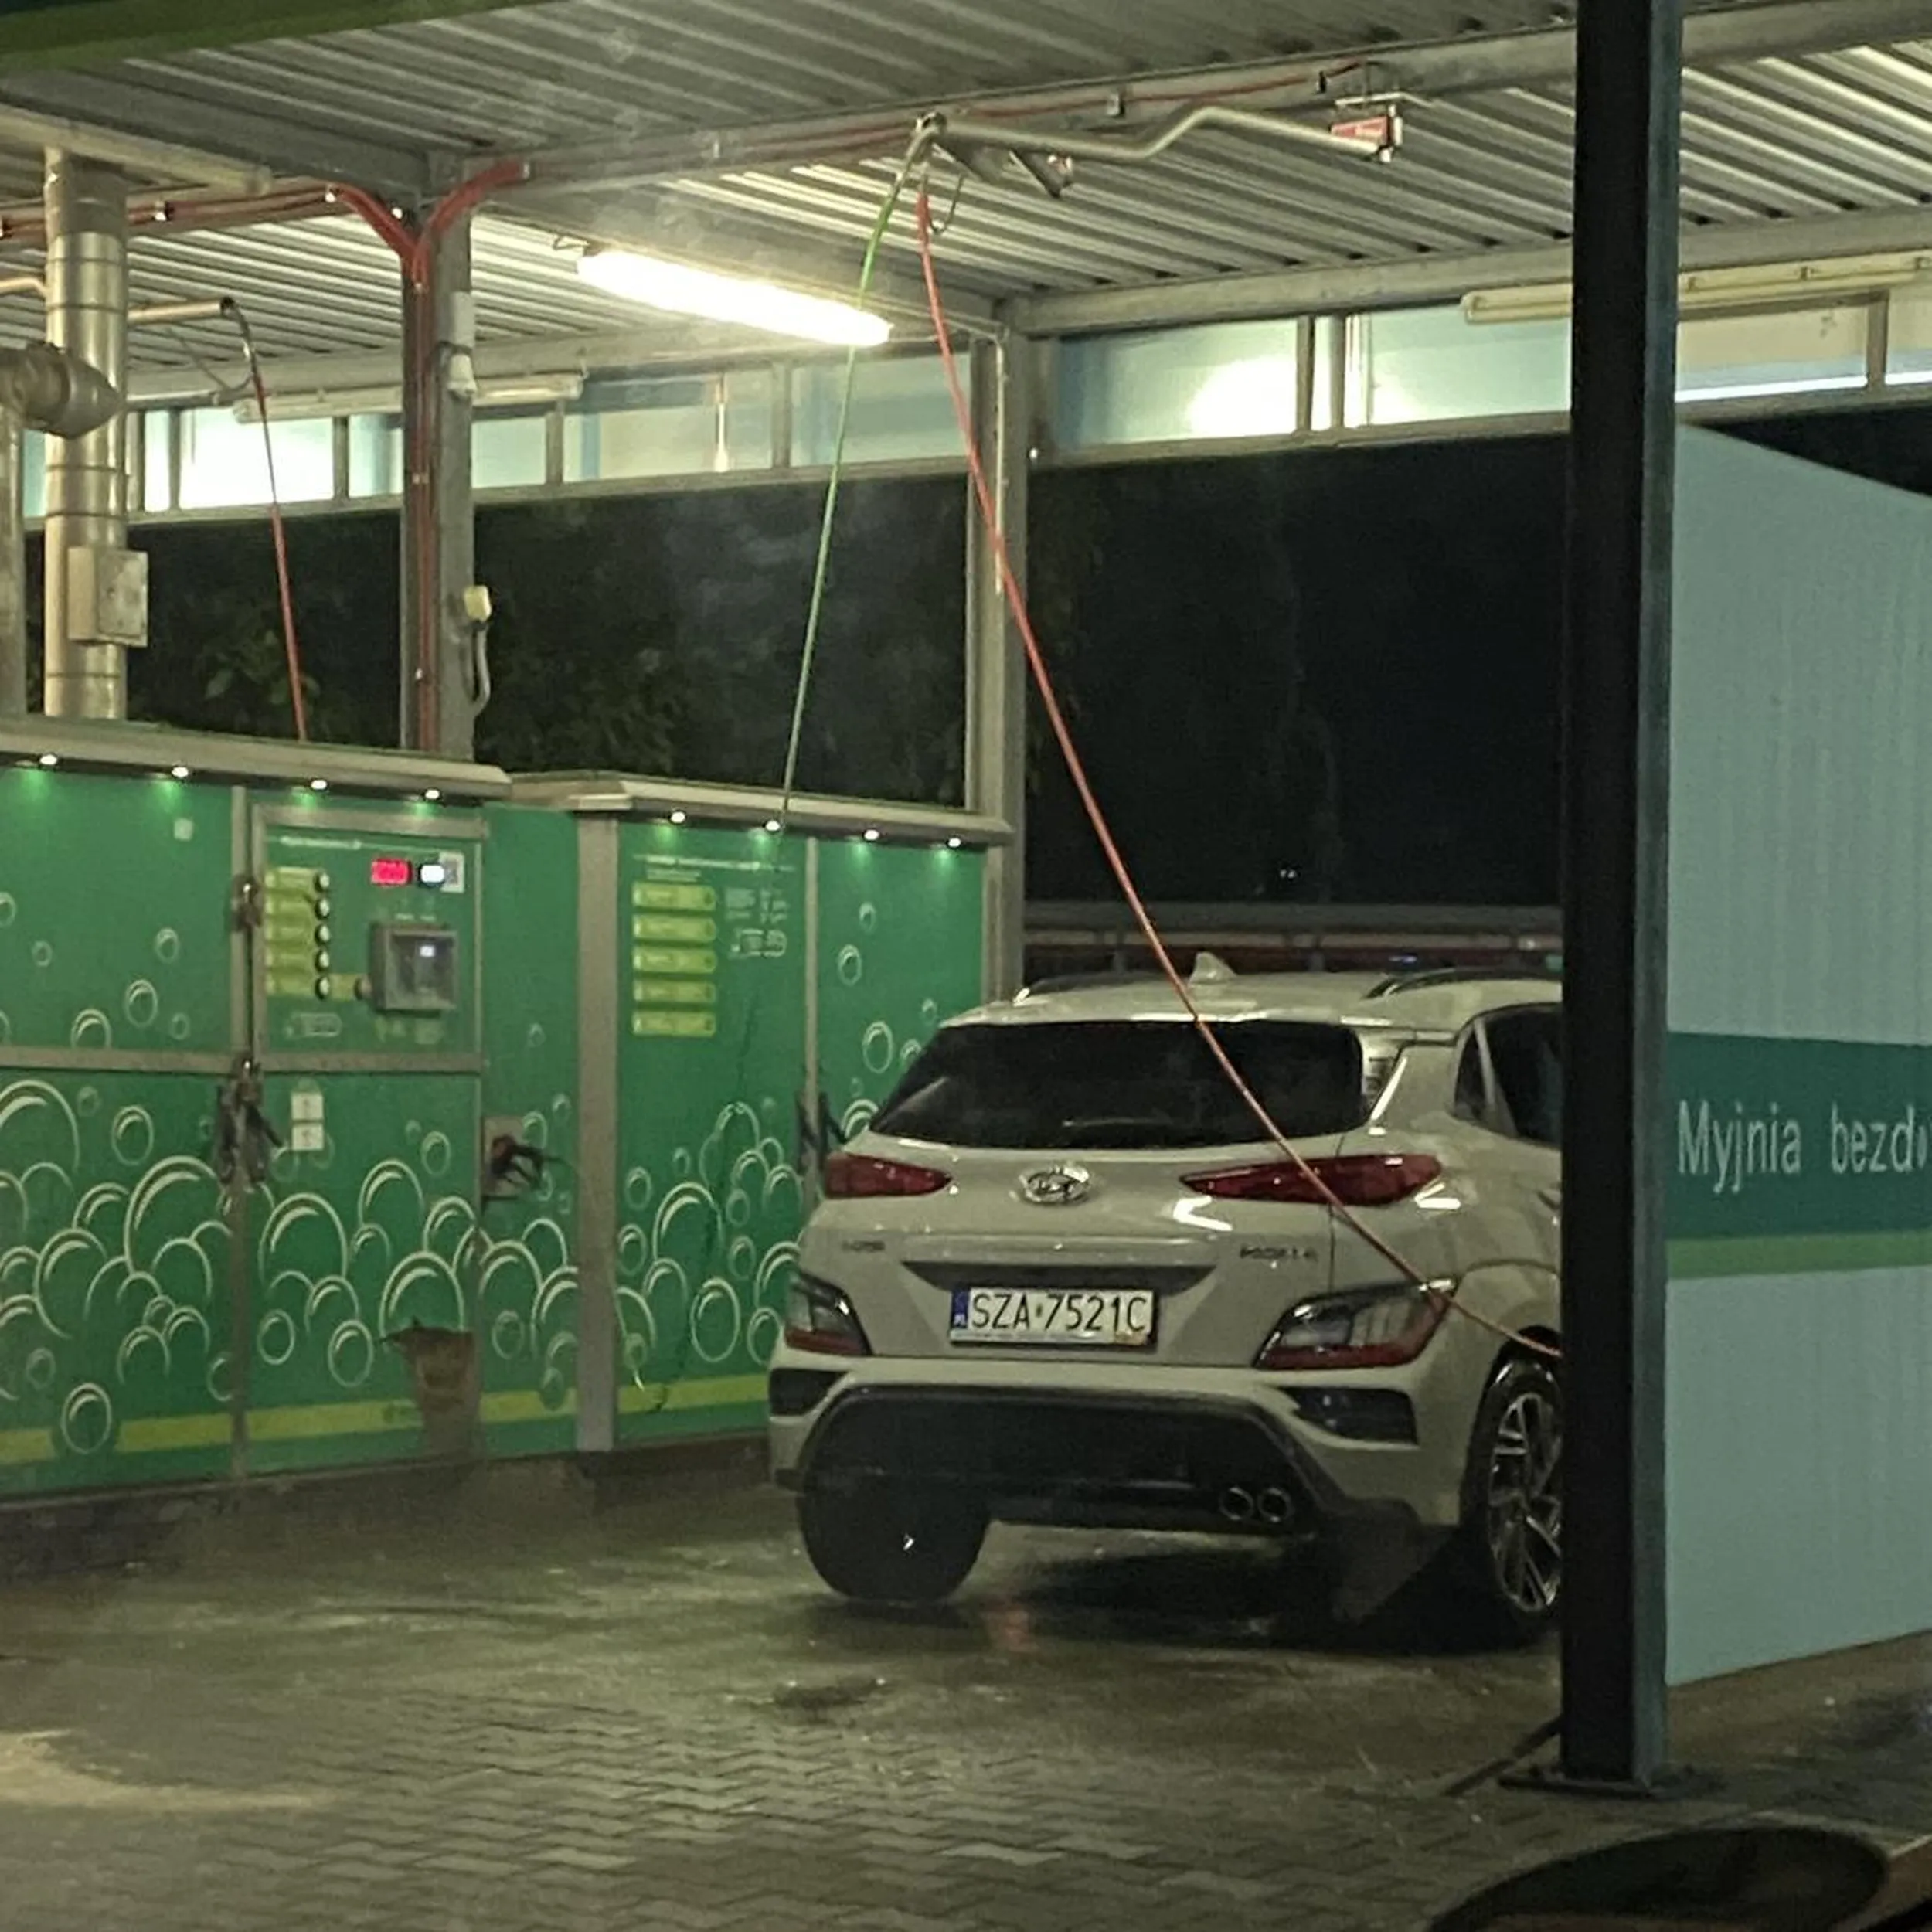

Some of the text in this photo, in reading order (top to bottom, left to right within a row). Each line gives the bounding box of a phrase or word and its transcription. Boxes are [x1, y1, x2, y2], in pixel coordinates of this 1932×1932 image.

[1679, 1100, 1801, 1193] Myjnia
[972, 1293, 1147, 1332] SZA 7521C
